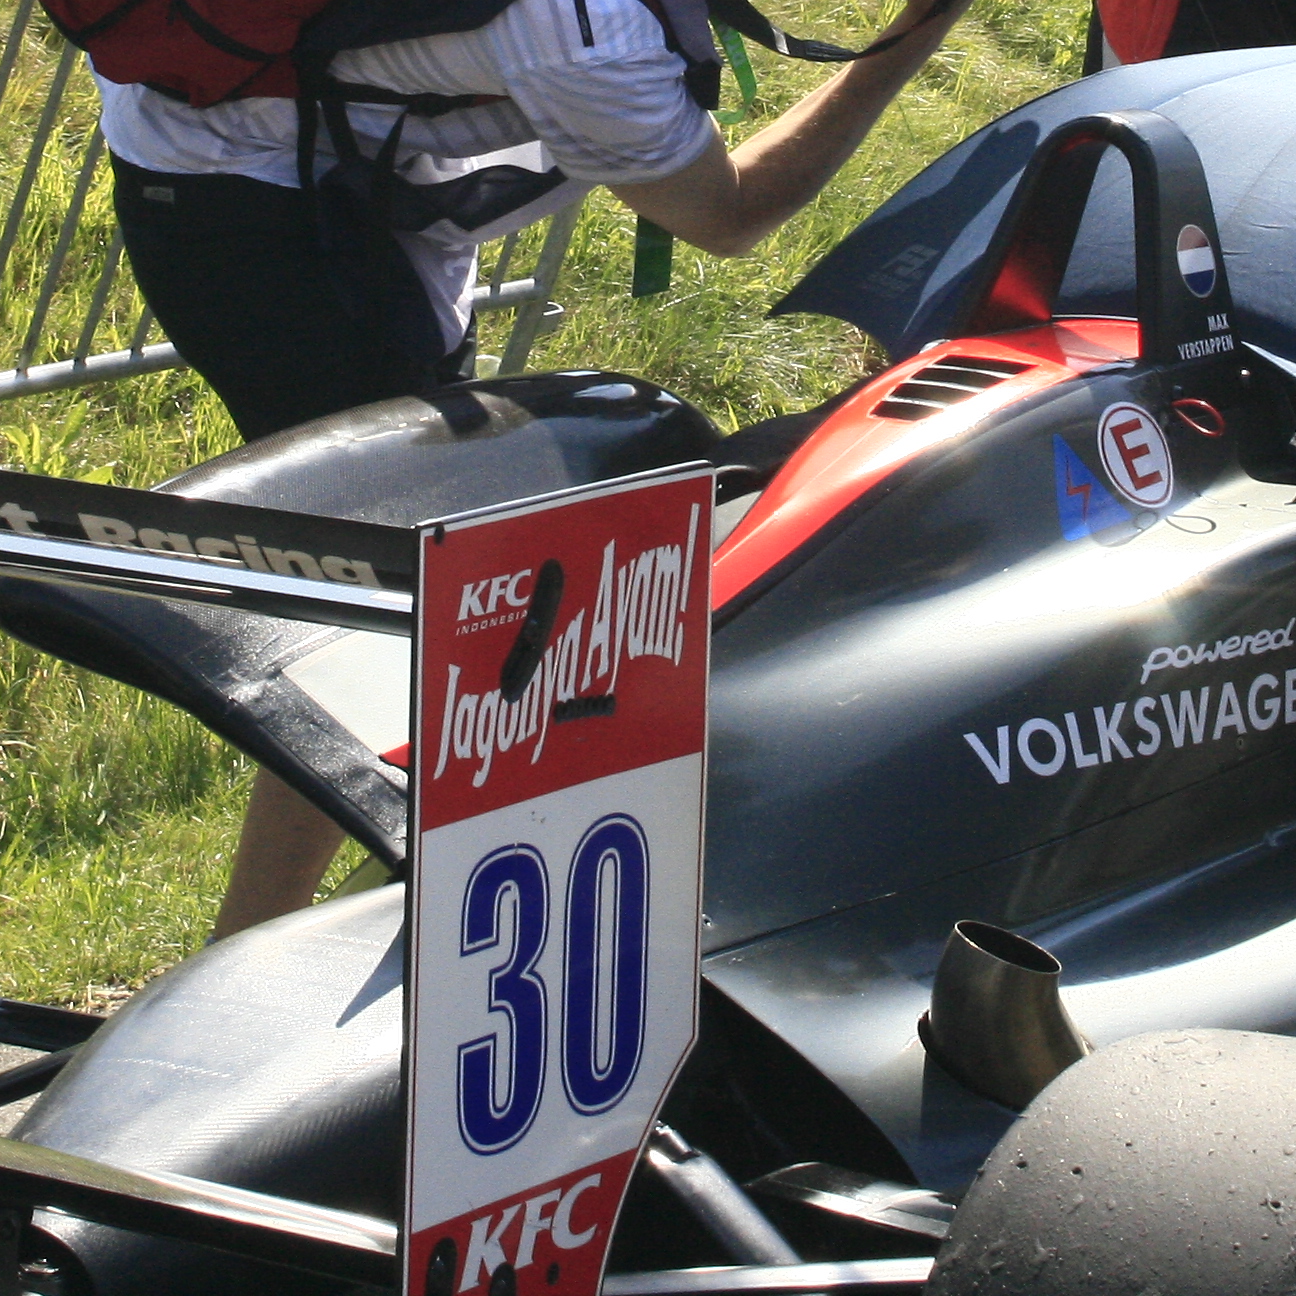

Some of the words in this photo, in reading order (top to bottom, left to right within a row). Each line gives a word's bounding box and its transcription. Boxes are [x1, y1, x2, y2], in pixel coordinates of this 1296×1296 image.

[1177, 334, 1235, 361] VERSTAPPEN
[1207, 312, 1230, 332] MAX
[1108, 416, 1164, 493] E
[78, 502, 383, 590] Racing
[455, 609, 529, 637] INDONESIA
[456, 568, 533, 622] KFC
[433, 607, 586, 789] Jagonya
[581, 502, 701, 696] Ayam!
[456, 812, 651, 1157] 30
[458, 1172, 602, 1294] KFC
